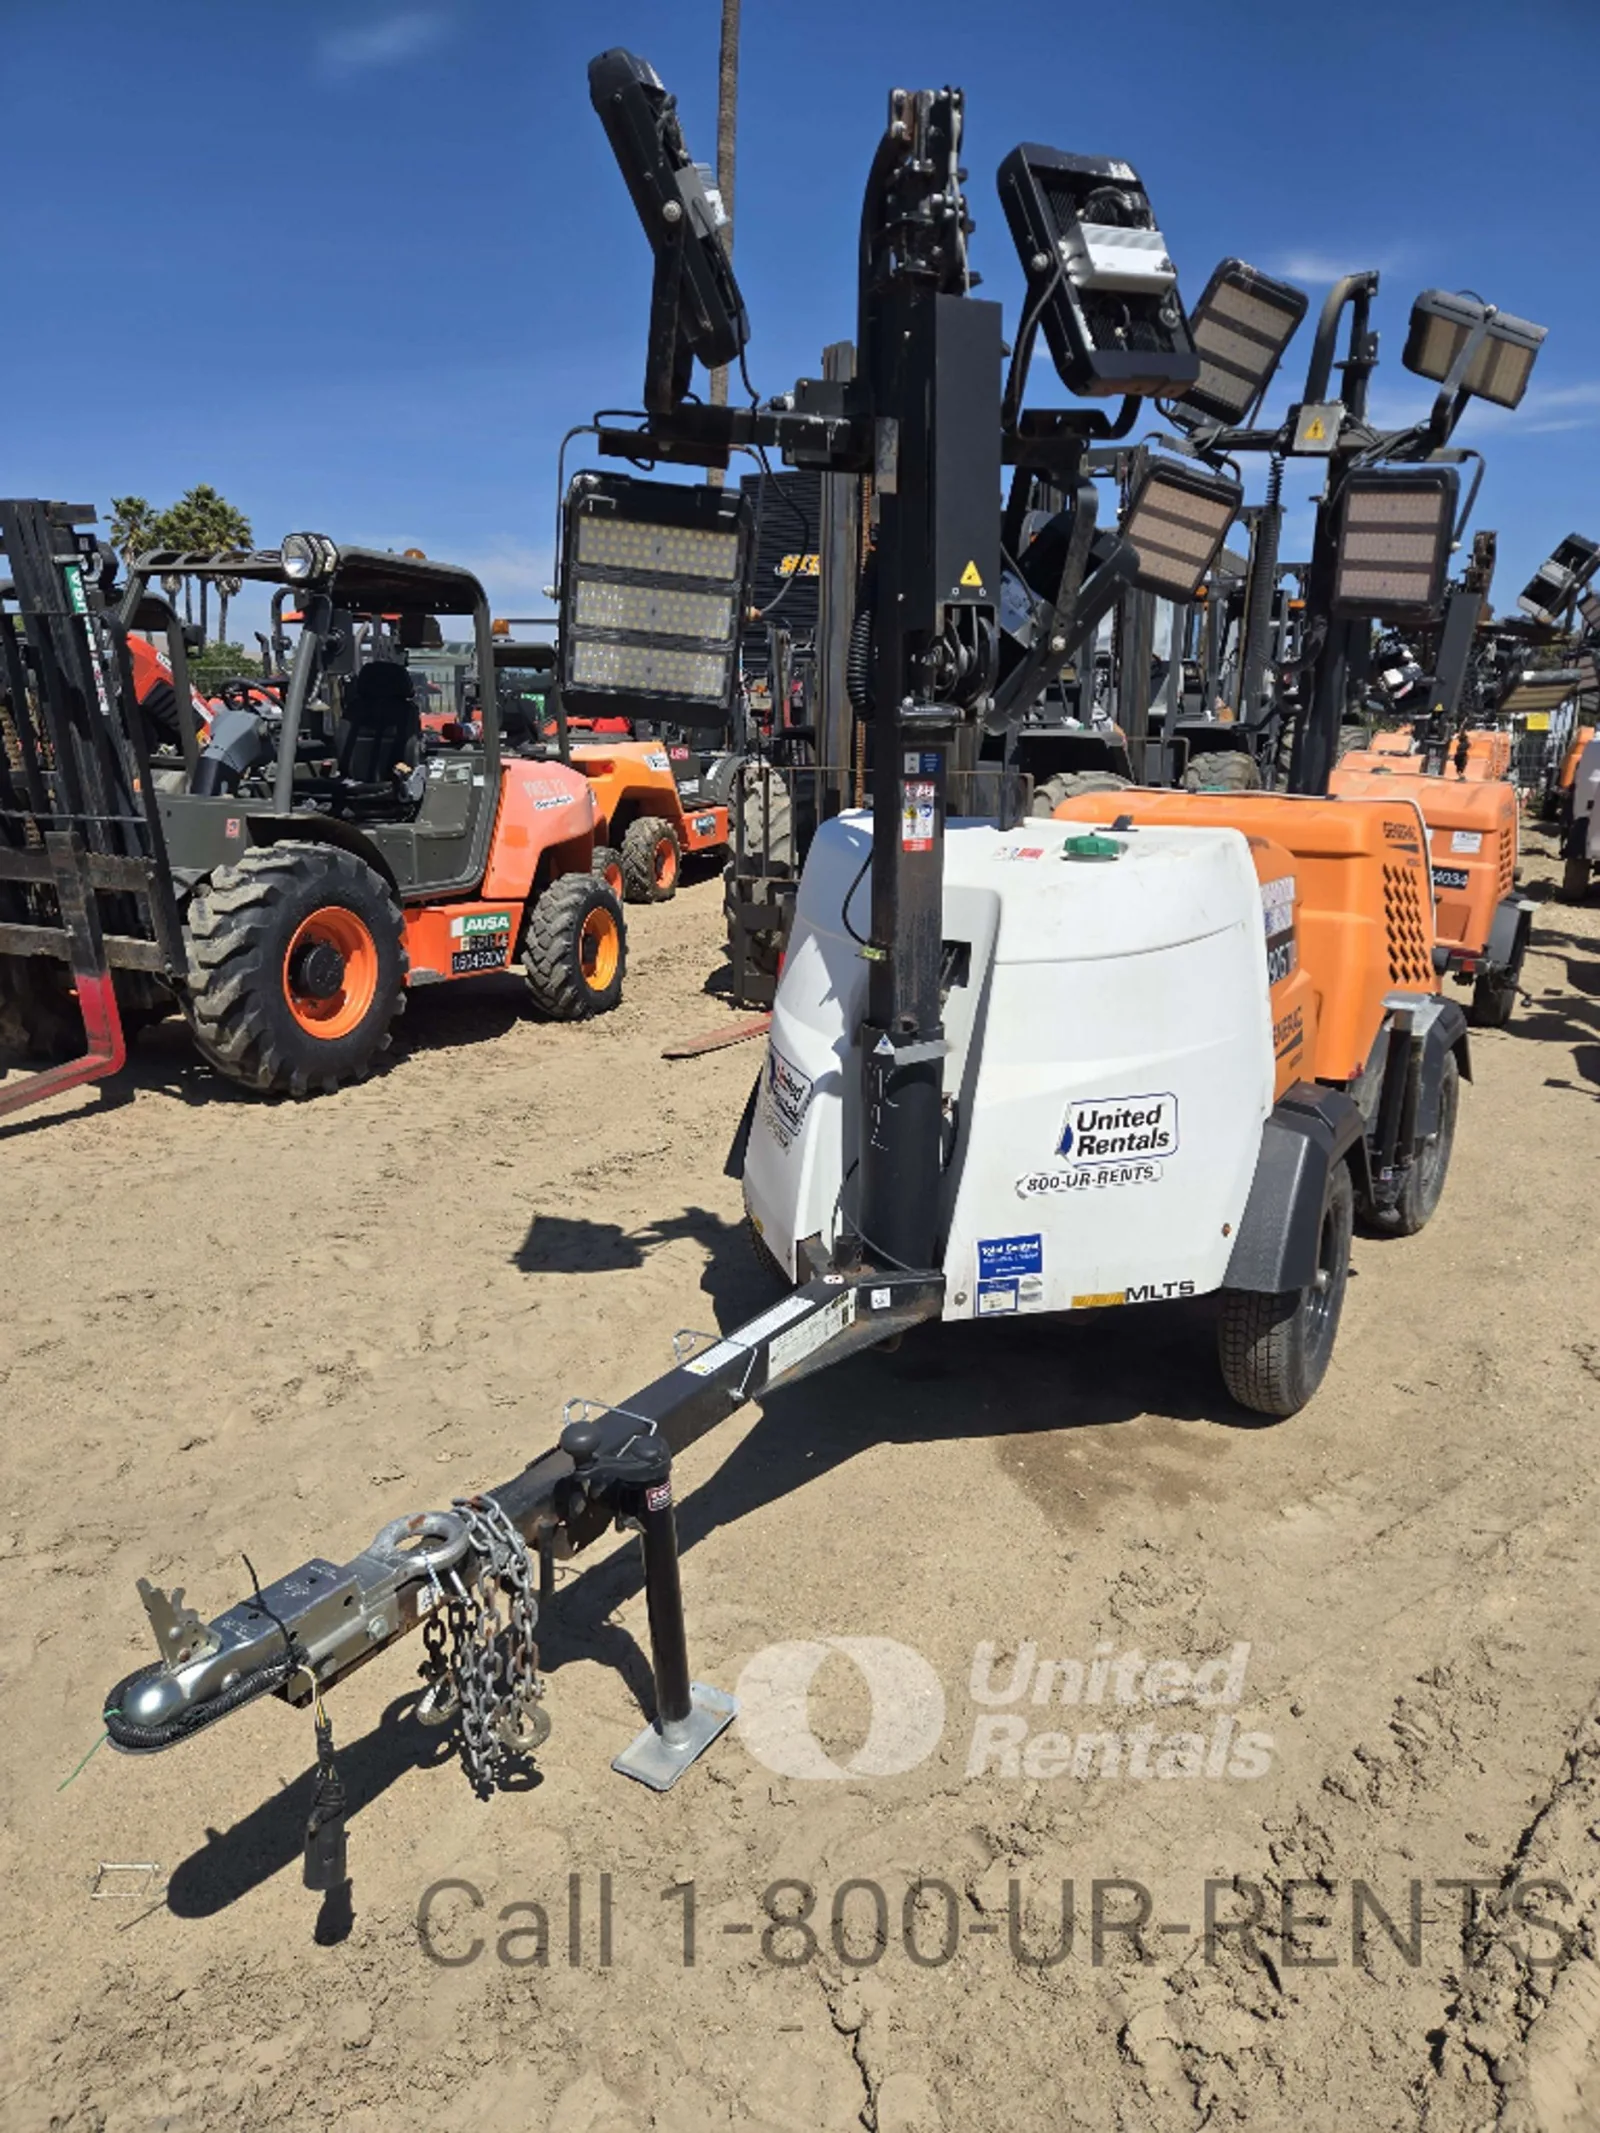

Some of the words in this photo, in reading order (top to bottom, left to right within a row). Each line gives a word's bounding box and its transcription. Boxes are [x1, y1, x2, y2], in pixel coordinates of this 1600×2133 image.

[1431, 869, 1468, 887] 4034
[465, 916, 510, 933] AUSA
[1077, 1103, 1163, 1132] United
[1077, 1127, 1170, 1157] Rentals
[1126, 1281, 1195, 1301] MLTS
